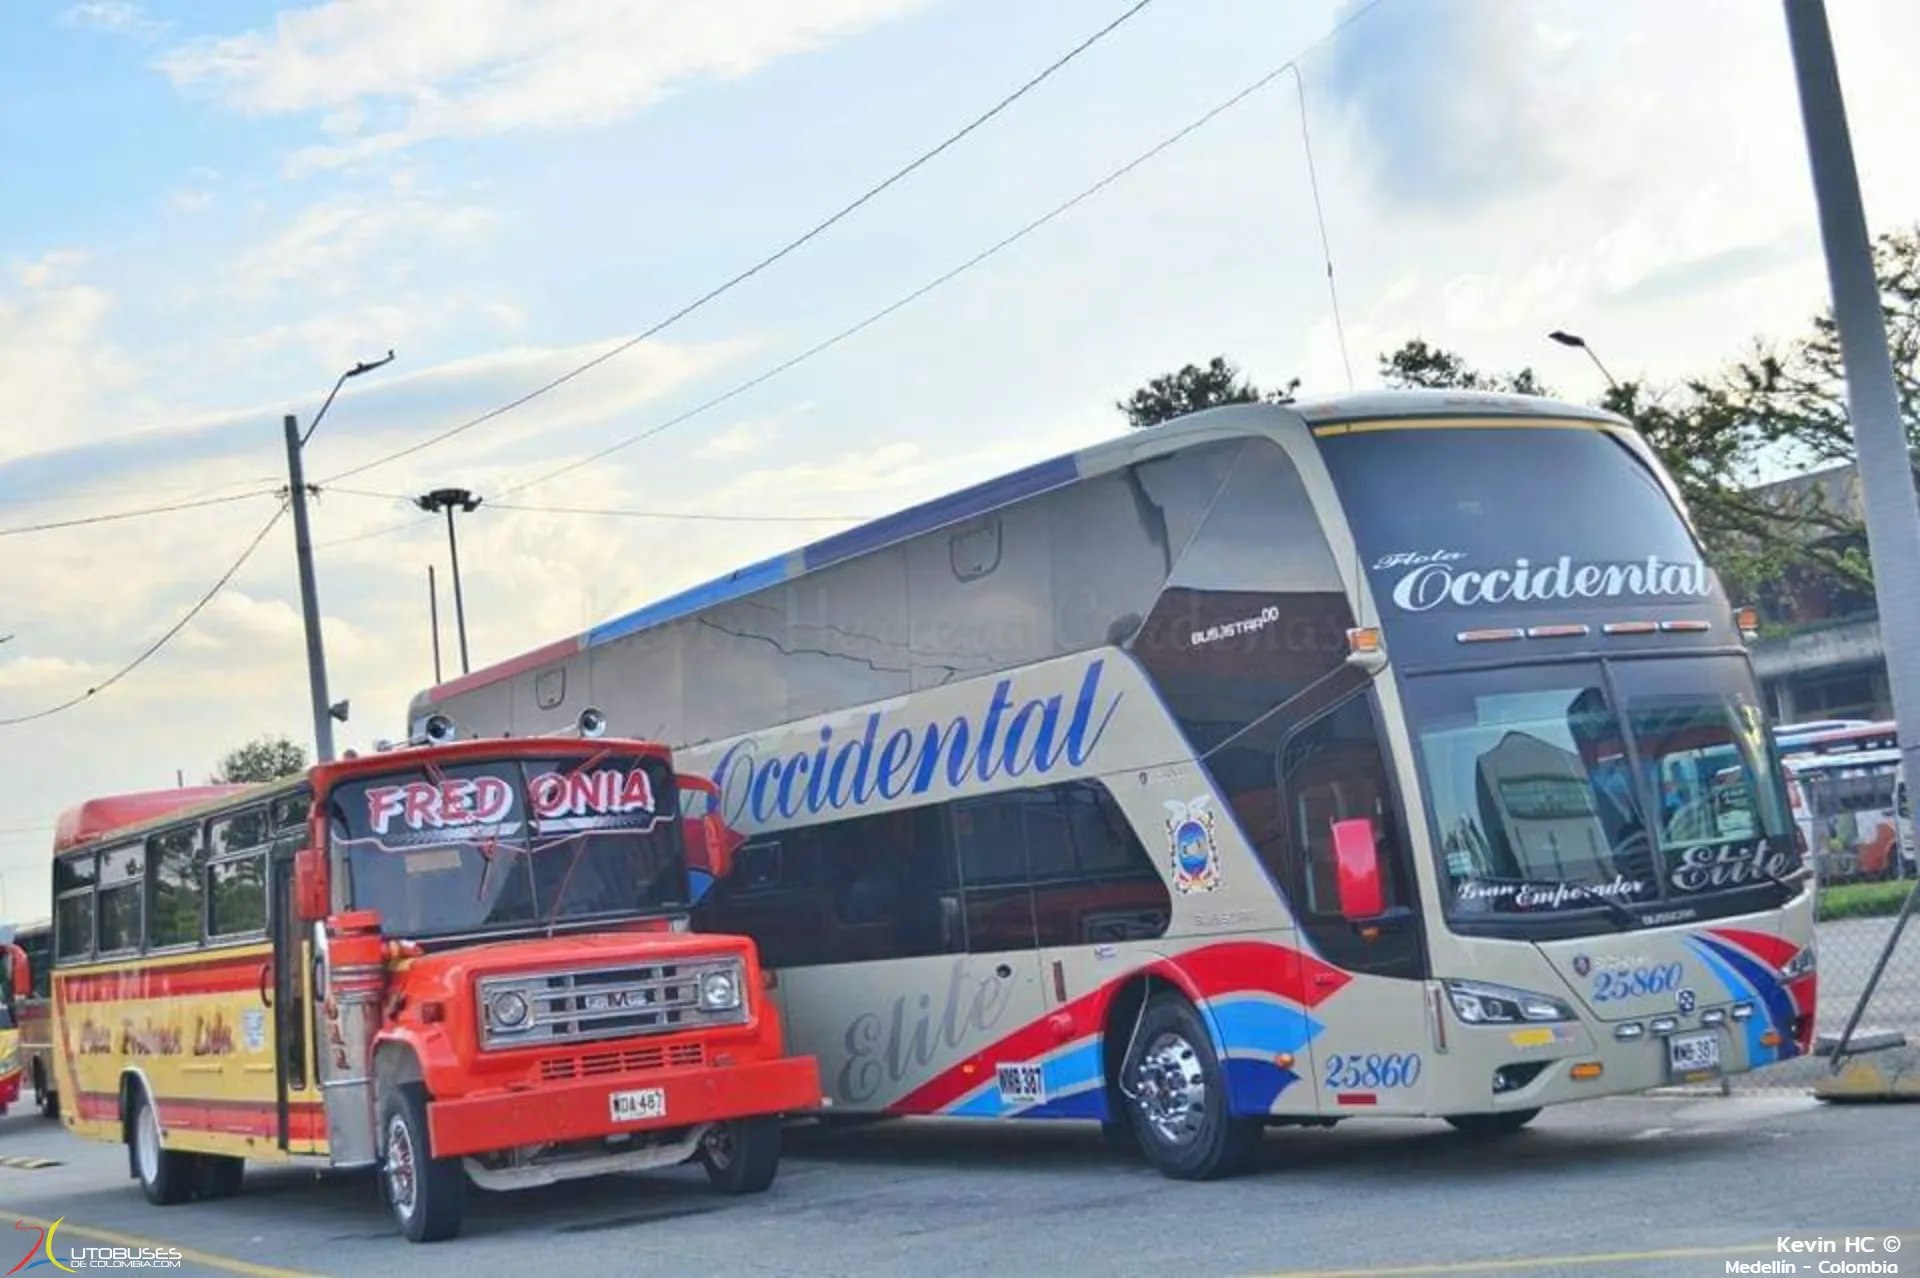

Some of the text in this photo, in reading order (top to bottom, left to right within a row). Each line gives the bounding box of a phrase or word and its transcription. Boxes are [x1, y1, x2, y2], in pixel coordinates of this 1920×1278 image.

[1392, 555, 1714, 612] Occidental
[706, 659, 1124, 828] Occidental
[365, 767, 656, 834] FRED ONIA
[1591, 961, 1684, 1004] 25860
[838, 956, 1018, 1104] Elite
[1324, 1052, 1422, 1089] 25860
